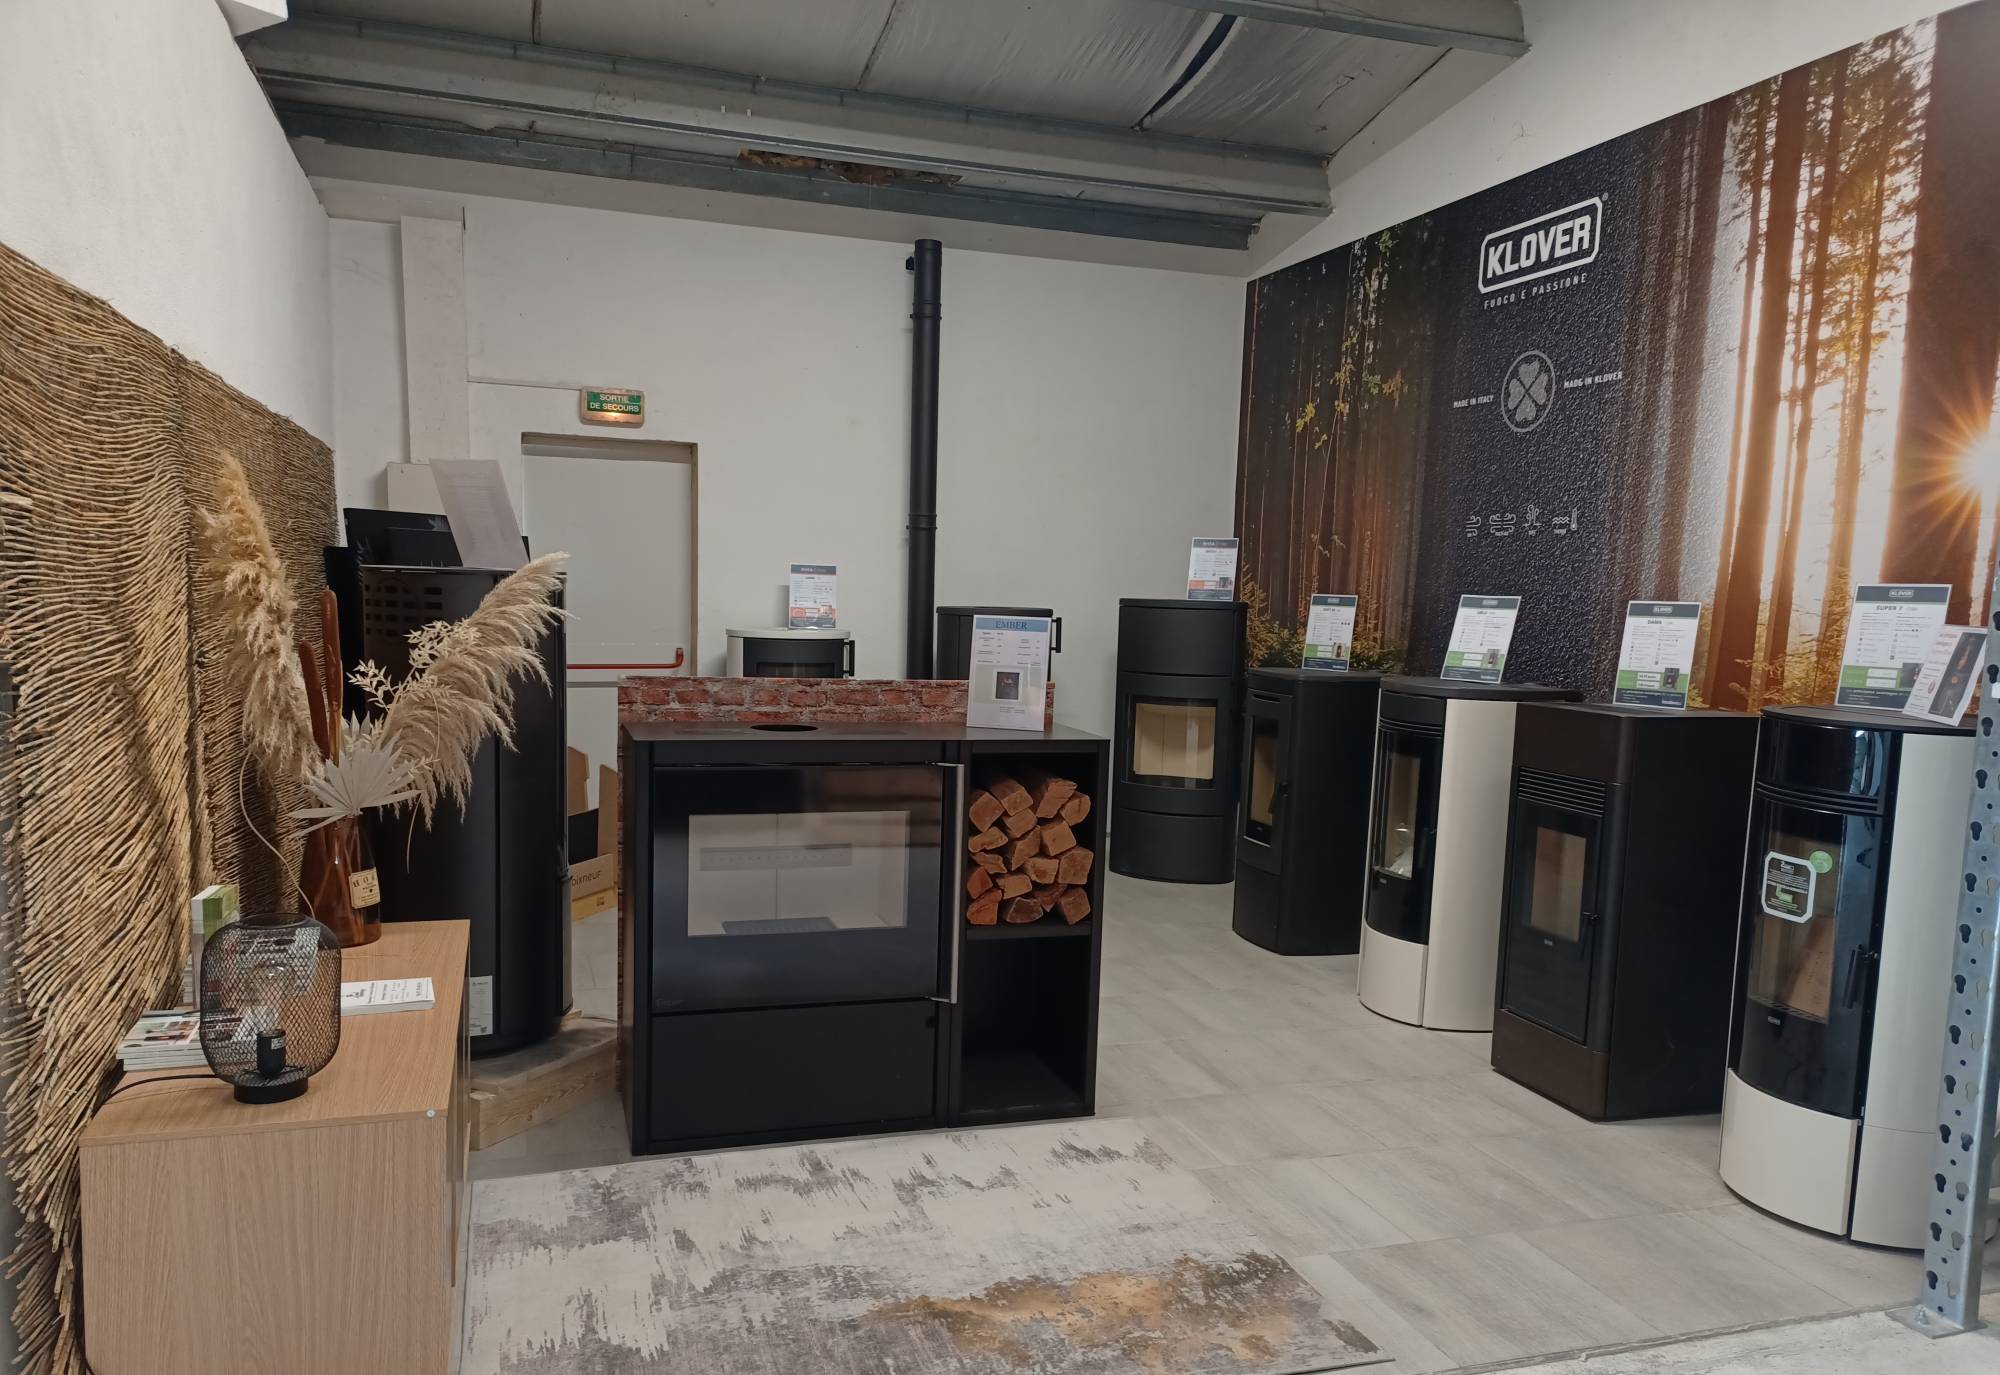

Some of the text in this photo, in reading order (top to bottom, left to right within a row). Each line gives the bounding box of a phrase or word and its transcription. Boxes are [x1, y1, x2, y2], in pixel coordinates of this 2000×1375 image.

[1487, 214, 1592, 279] KLOVER
[1484, 272, 1588, 310] FUOCO E PASSIONE
[1594, 370, 1623, 384] KLOVER
[602, 403, 639, 412] SECOURS
[995, 620, 1028, 630] EMBER
